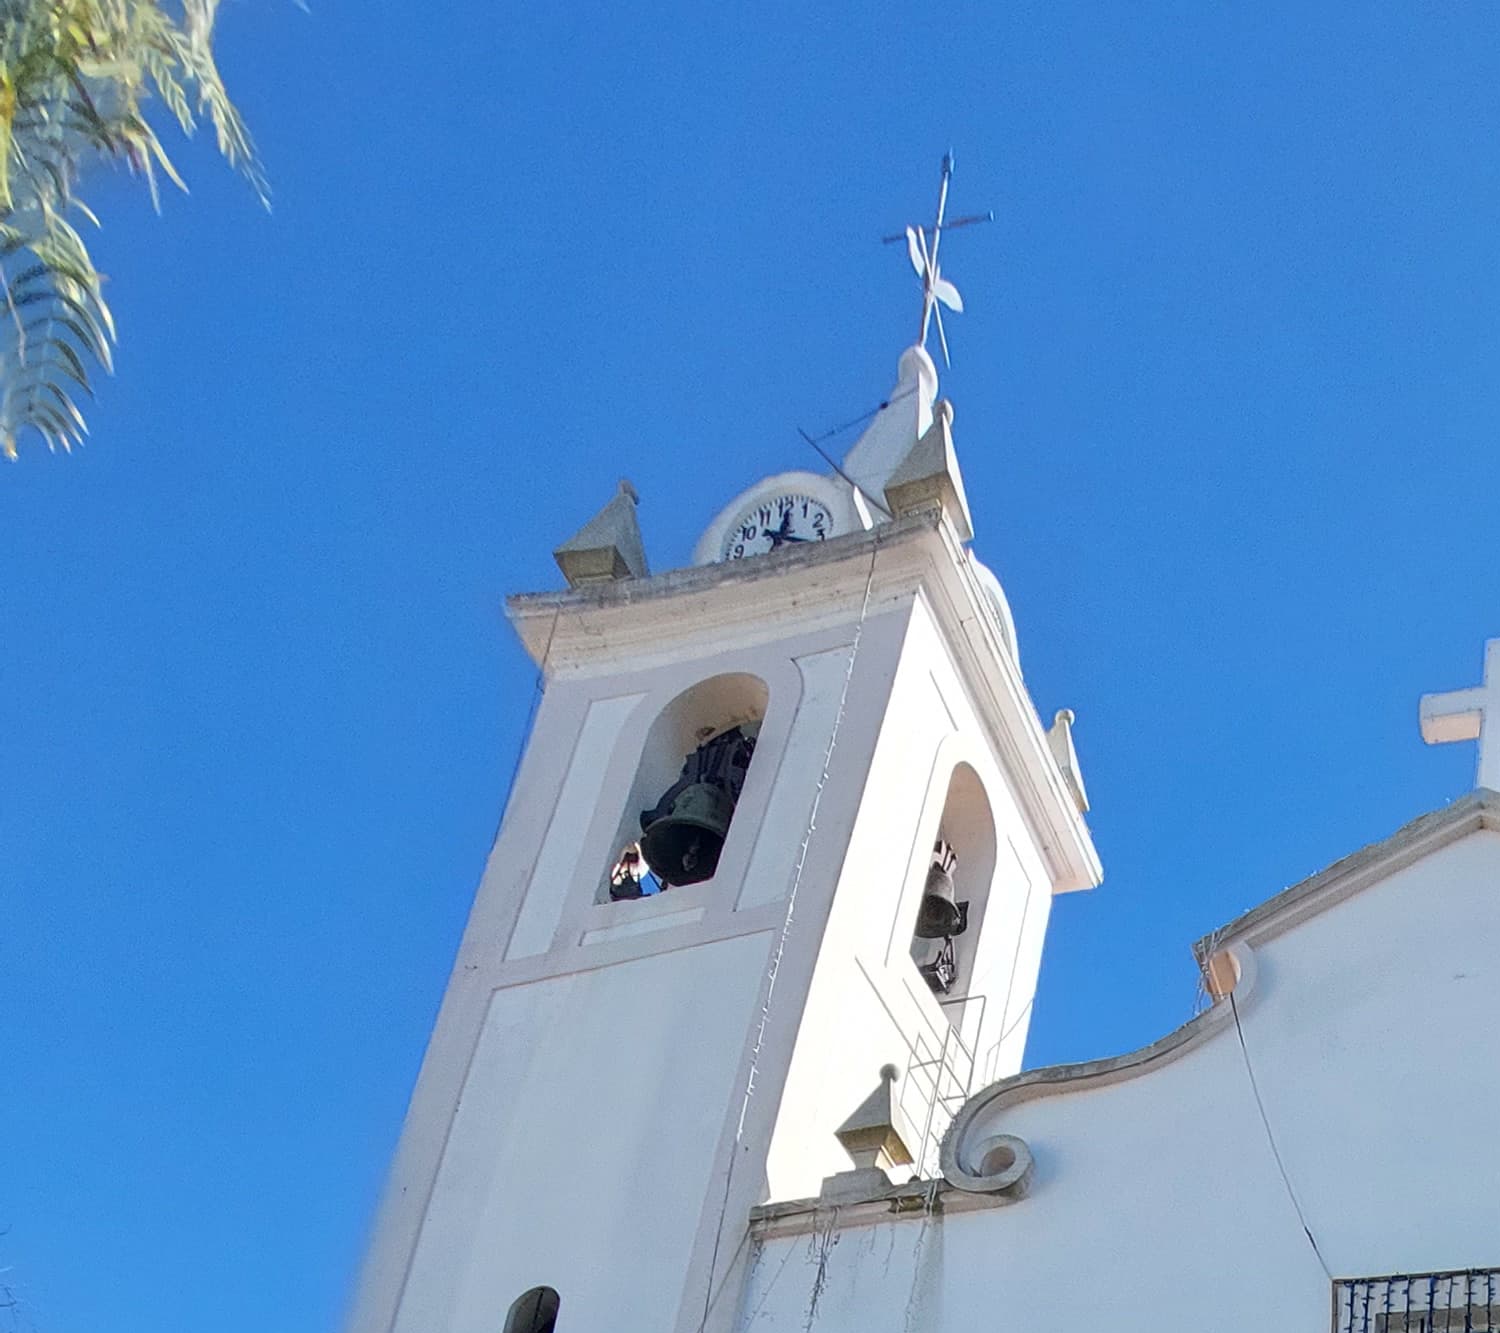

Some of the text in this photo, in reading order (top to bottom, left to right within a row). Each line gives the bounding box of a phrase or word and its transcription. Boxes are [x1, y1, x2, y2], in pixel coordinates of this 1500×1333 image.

[778, 500, 794, 517] 12
[802, 504, 808, 518] 1
[759, 508, 770, 526] 11
[812, 513, 824, 528] 2
[742, 526, 756, 541] 10
[734, 545, 744, 559] 9
